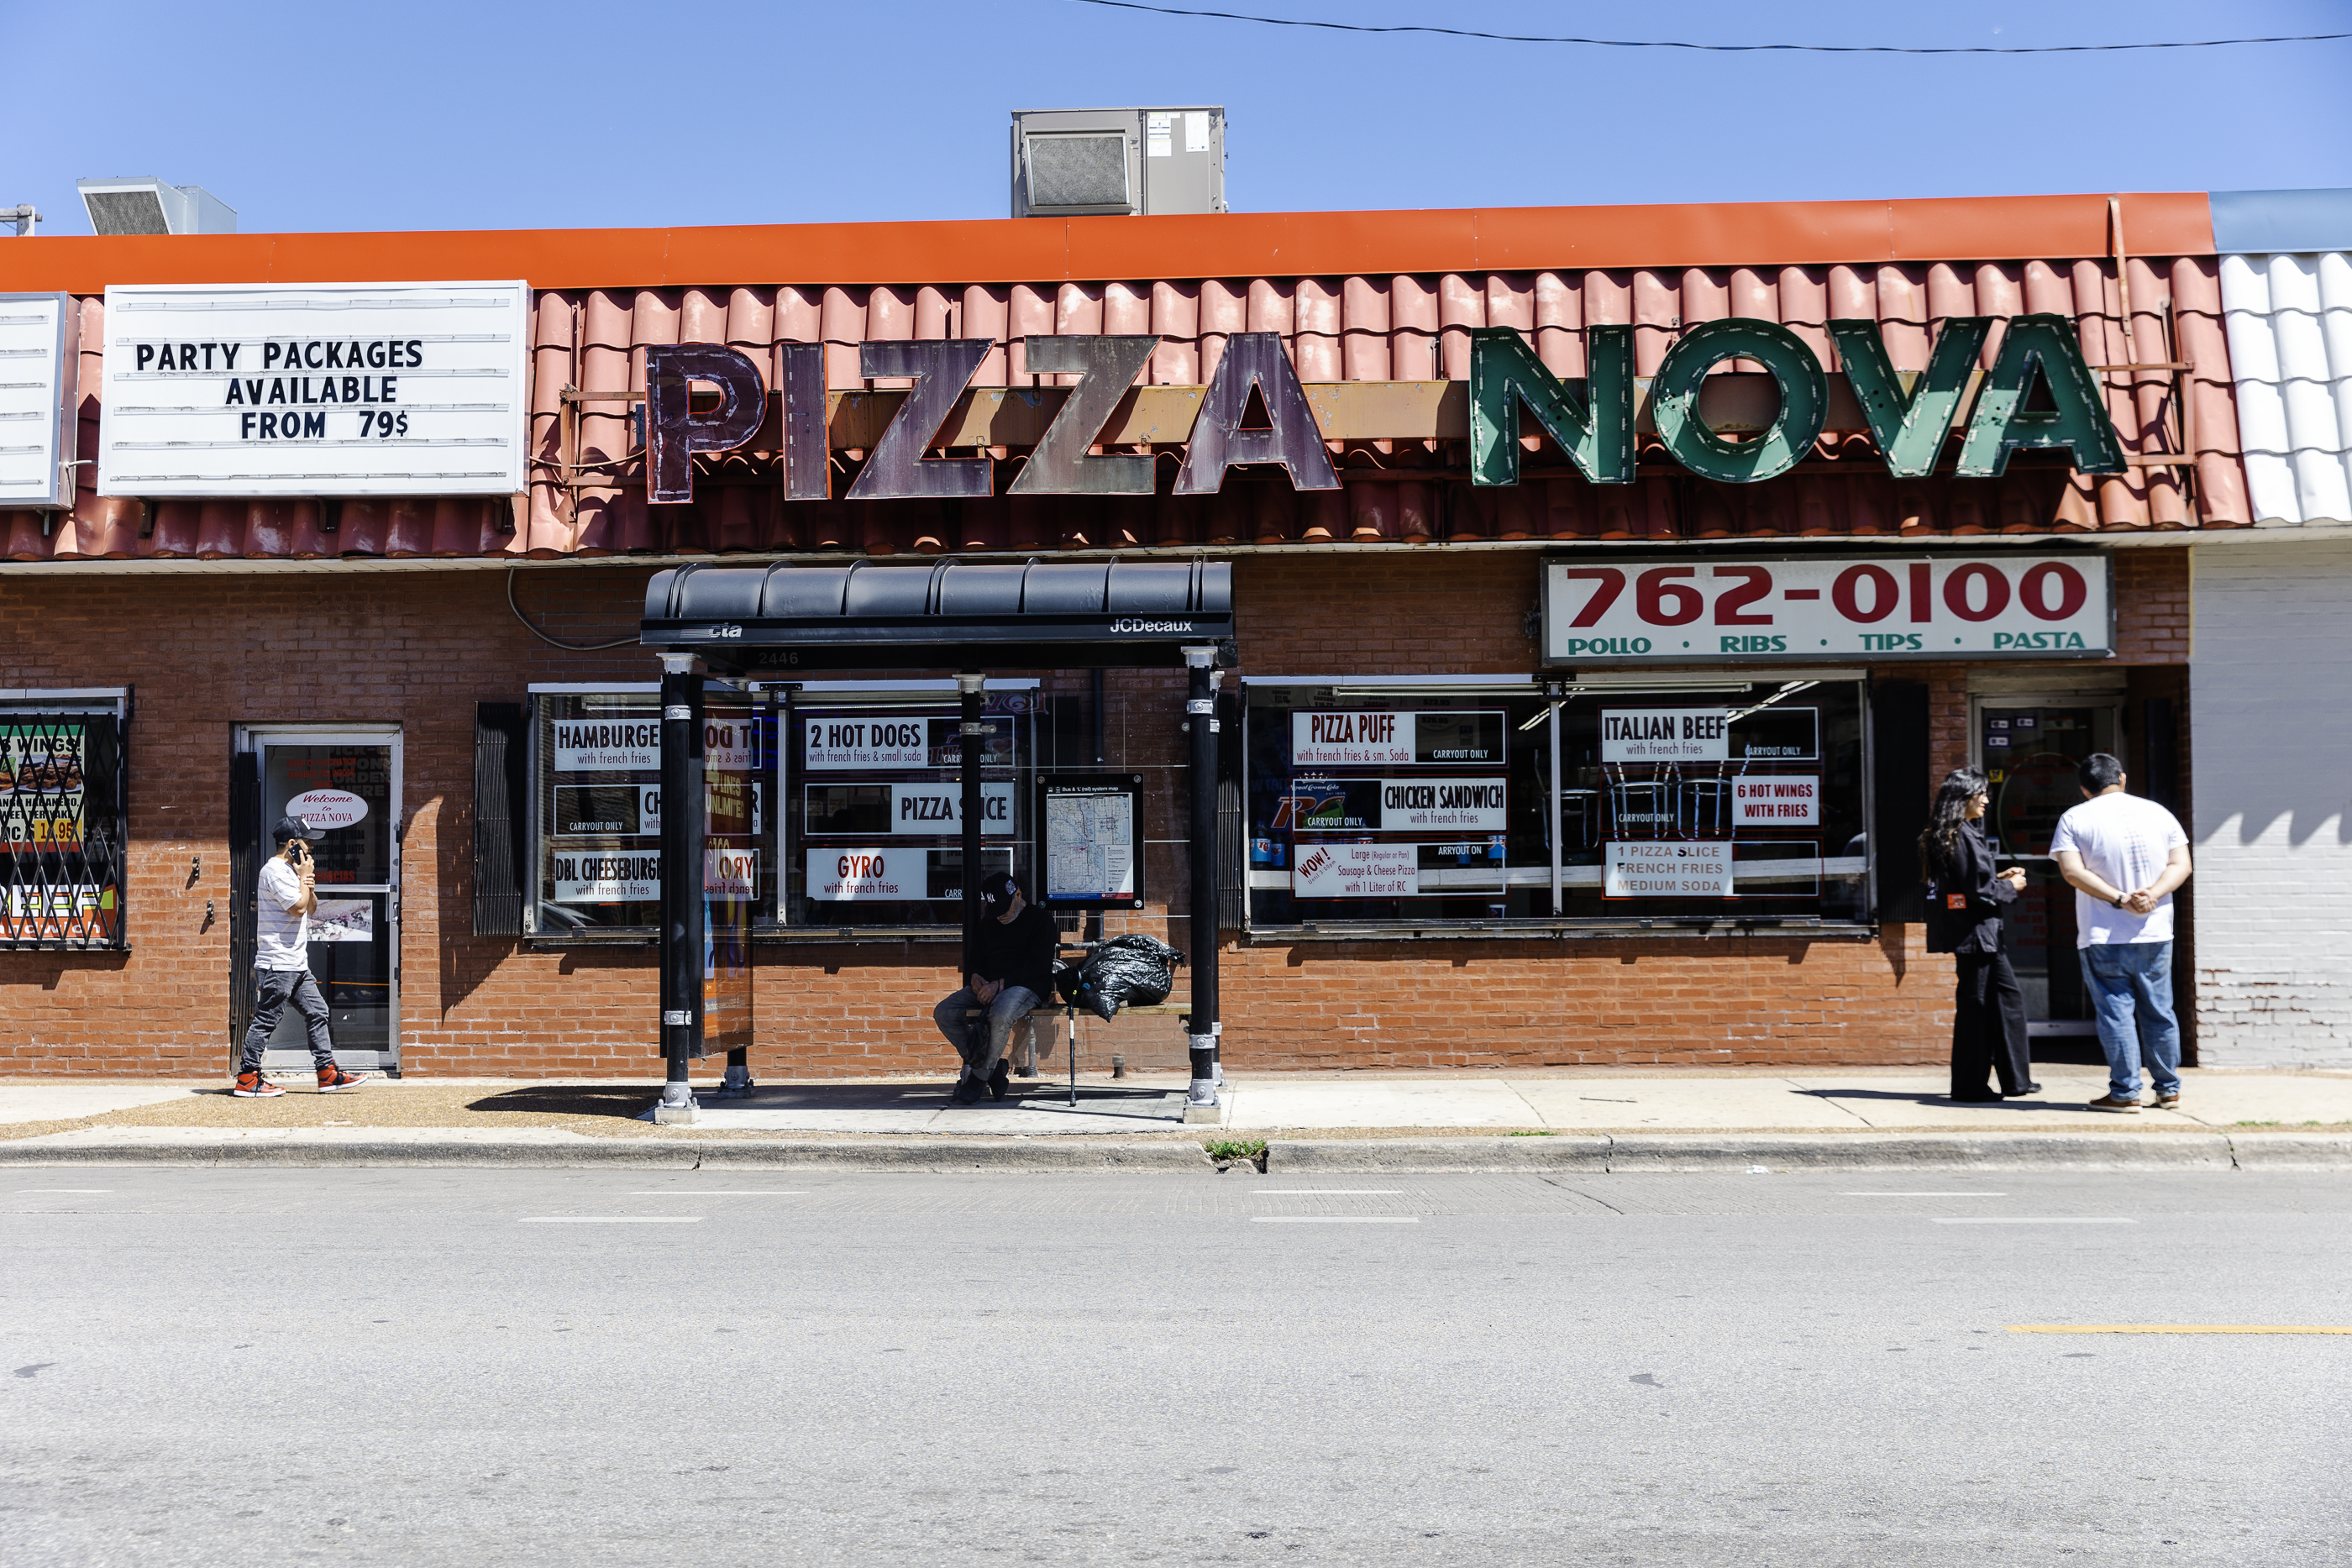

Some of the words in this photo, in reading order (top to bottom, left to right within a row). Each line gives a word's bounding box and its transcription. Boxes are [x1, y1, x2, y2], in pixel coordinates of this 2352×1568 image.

[136, 343, 241, 371] PARTY
[263, 340, 423, 370] PACKAGES
[225, 376, 397, 405] AVAILABLE
[643, 332, 1344, 504] PIZZA
[1470, 313, 2129, 486] NOVA
[241, 412, 327, 439] FROM
[359, 410, 409, 438] 79$
[1567, 561, 2087, 628] 762-0100
[708, 622, 743, 638] cta
[1110, 619, 1193, 632] JCDecaux
[1567, 637, 1652, 655] POLLO
[1720, 635, 1788, 653] RIBS
[1858, 632, 1923, 651] TIPS
[1993, 632, 2086, 650] PASTA
[759, 652, 799, 665] 2446
[1311, 714, 1354, 743] PIZZA
[1359, 714, 1395, 743] PUFF
[1604, 716, 1675, 741] ITALIAN
[1683, 716, 1726, 740] BEEF
[559, 725, 661, 749] HAMBURGE
[811, 726, 822, 747] 2
[828, 725, 865, 747] HOT
[871, 724, 921, 747] DOGS
[17, 737, 81, 753] WINGS!
[1626, 743, 1647, 755] with
[1650, 742, 1678, 755] french
[1682, 742, 1703, 754] fries
[1745, 747, 1781, 756] CARRYOUT
[1782, 746, 1801, 755] ONLY
[577, 752, 596, 764] with
[599, 751, 627, 764] french
[631, 751, 651, 764] fries
[809, 751, 826, 763] with
[827, 751, 852, 762] french
[853, 750, 870, 762] fries
[873, 752, 879, 762] &
[881, 750, 901, 762] small
[904, 749, 921, 761] soda
[943, 754, 962, 763] CARR
[980, 754, 998, 763] ONLY
[1297, 750, 1314, 762] with
[1315, 749, 1341, 762] french
[1344, 749, 1362, 762] fries
[1364, 750, 1370, 761] &
[1373, 753, 1387, 762] sm.
[1389, 749, 1409, 762] Soda
[1433, 750, 1469, 759] CARRYOUT
[1470, 749, 1488, 758] ONLY
[286, 759, 306, 768] PROOF
[307, 758, 316, 767] OF
[317, 758, 357, 767] VACCINATION
[288, 769, 318, 779] REQUIRED
[319, 769, 331, 778] FOR
[333, 768, 355, 778] INDOOR
[706, 748, 720, 791] 4
[720, 774, 742, 797] LINES
[312, 780, 333, 789] DINING
[1738, 784, 1746, 798] 6
[1750, 784, 1771, 797] HOT
[1774, 784, 1812, 797] WINGS
[302, 794, 353, 803] Welcome
[1385, 786, 1435, 809] CHICKEN
[1439, 785, 1504, 809] SANDWICH
[706, 793, 745, 819] UNLIMITED
[901, 797, 953, 821] PIZZA
[959, 797, 1007, 820] ICE
[1745, 805, 1774, 817] WITH
[1777, 804, 1808, 817] FRIES
[301, 813, 327, 821] PIZZA
[328, 813, 353, 821] NOVA
[1307, 817, 1342, 826] CARRYOUT
[1344, 816, 1362, 826] ONLY
[1410, 812, 1429, 824] with
[1431, 812, 1457, 824] french
[1459, 812, 1478, 824] fries
[1619, 813, 1656, 823] CARRYOUT
[1656, 813, 1675, 822] ONLY
[570, 821, 603, 831] CARRYOUT
[605, 821, 623, 831] ONLY
[1352, 848, 1370, 861] Large
[1371, 849, 1391, 861] (Regular
[1399, 849, 1410, 861] Pan)
[1438, 846, 1470, 855] ARRYOUT
[1471, 846, 1483, 855] ON
[1618, 847, 1625, 857] 1
[1630, 847, 1672, 857] PIZZA
[1677, 847, 1720, 857] SLICE
[837, 855, 885, 878] GYRO
[1298, 847, 1331, 878] WOW!
[1617, 863, 1676, 874] FRENCH
[1682, 863, 1723, 874] FRIES
[555, 857, 578, 882] DBL
[581, 857, 661, 881] CHEESEBURGE
[1308, 873, 1320, 884] Until
[1320, 860, 1336, 875] 3:00pm
[1338, 865, 1365, 878] Sausage
[1367, 866, 1373, 876] &
[1373, 865, 1396, 876] Cheese
[1398, 865, 1415, 876] Pizza
[315, 870, 354, 883] GRACIAS
[575, 884, 595, 895] with
[598, 883, 627, 895] french
[629, 883, 649, 895] fries
[824, 883, 843, 894] with
[847, 882, 876, 894] french
[878, 881, 899, 894] fries
[1345, 881, 1361, 892] with
[1362, 881, 1367, 892] 1
[1368, 880, 1385, 892] Liter
[1387, 880, 1395, 892] of
[1397, 881, 1406, 892] RC
[1618, 880, 1676, 891] MEDIUM
[1682, 880, 1721, 891] SODA
[944, 889, 962, 898] CARR
